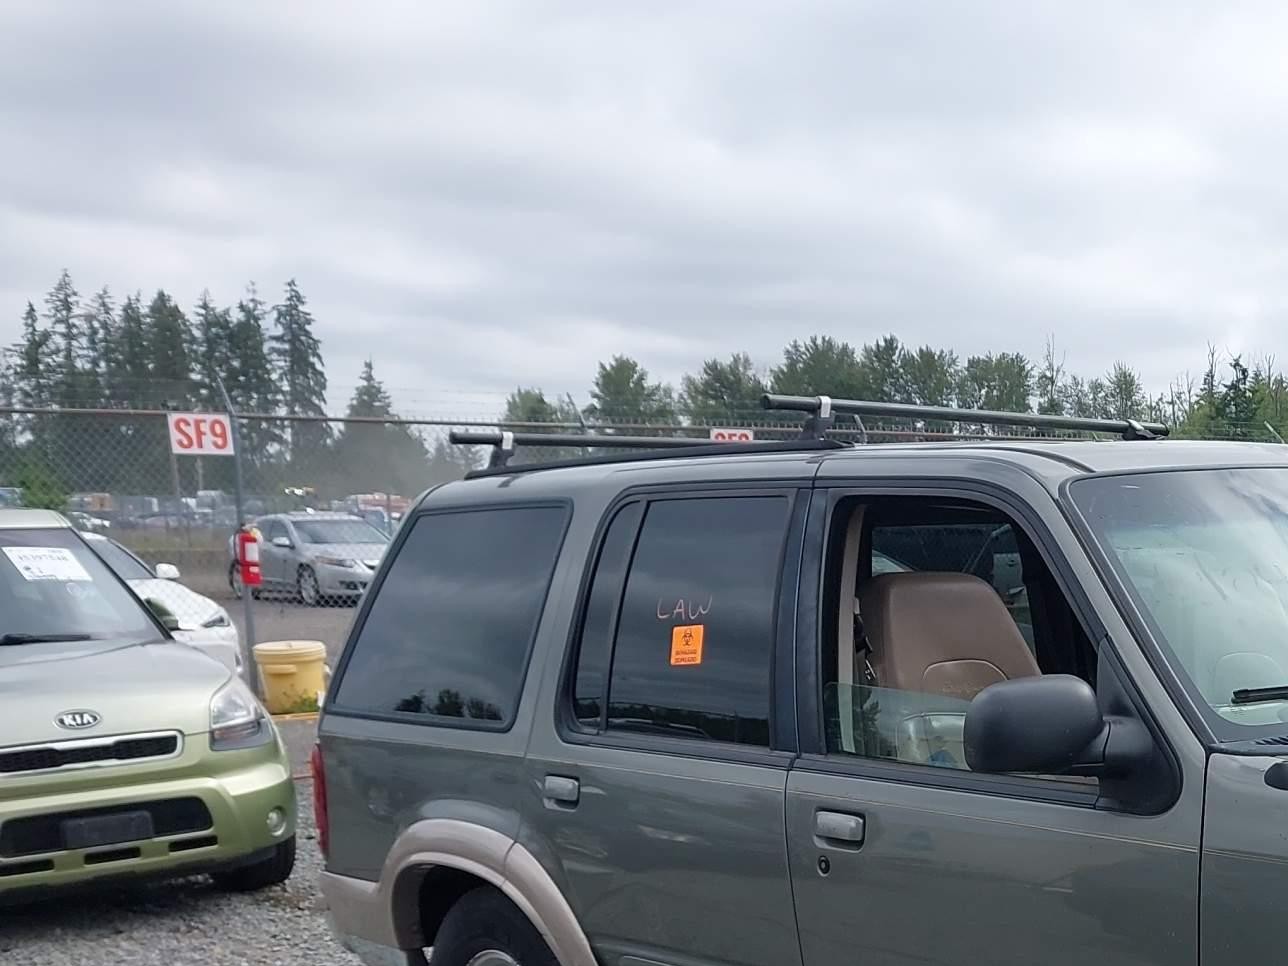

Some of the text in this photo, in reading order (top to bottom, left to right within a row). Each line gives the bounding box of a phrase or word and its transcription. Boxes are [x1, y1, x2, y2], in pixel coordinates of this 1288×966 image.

[173, 416, 229, 450] SF9
[656, 594, 713, 620] LAW
[62, 712, 94, 727] KIA
